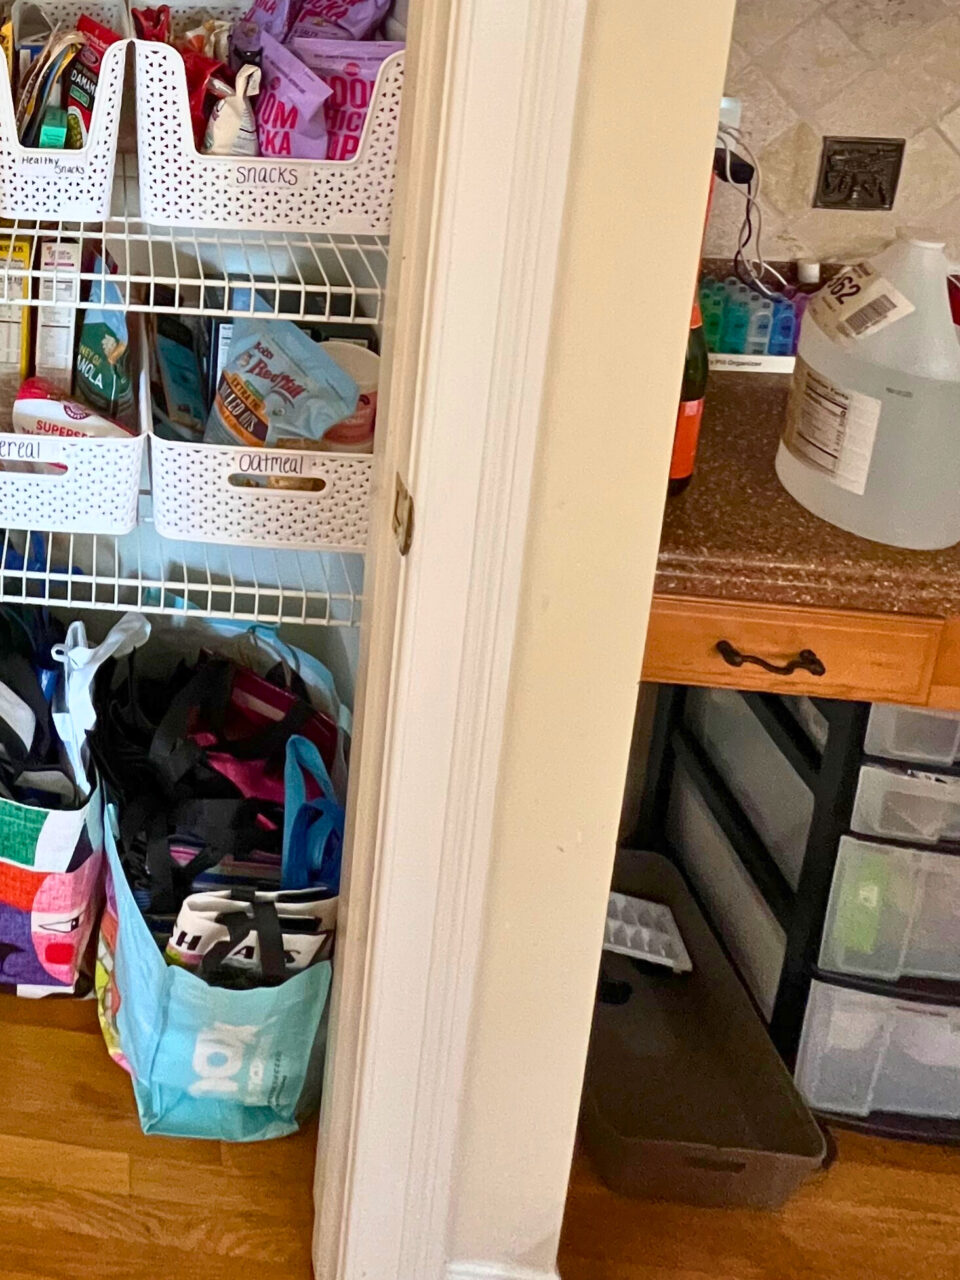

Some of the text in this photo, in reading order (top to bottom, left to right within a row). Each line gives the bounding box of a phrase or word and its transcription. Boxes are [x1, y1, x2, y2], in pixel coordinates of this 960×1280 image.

[22, 155, 60, 169] Healthy
[236, 166, 298, 186] Snacks
[239, 453, 303, 474] Oatmeal
